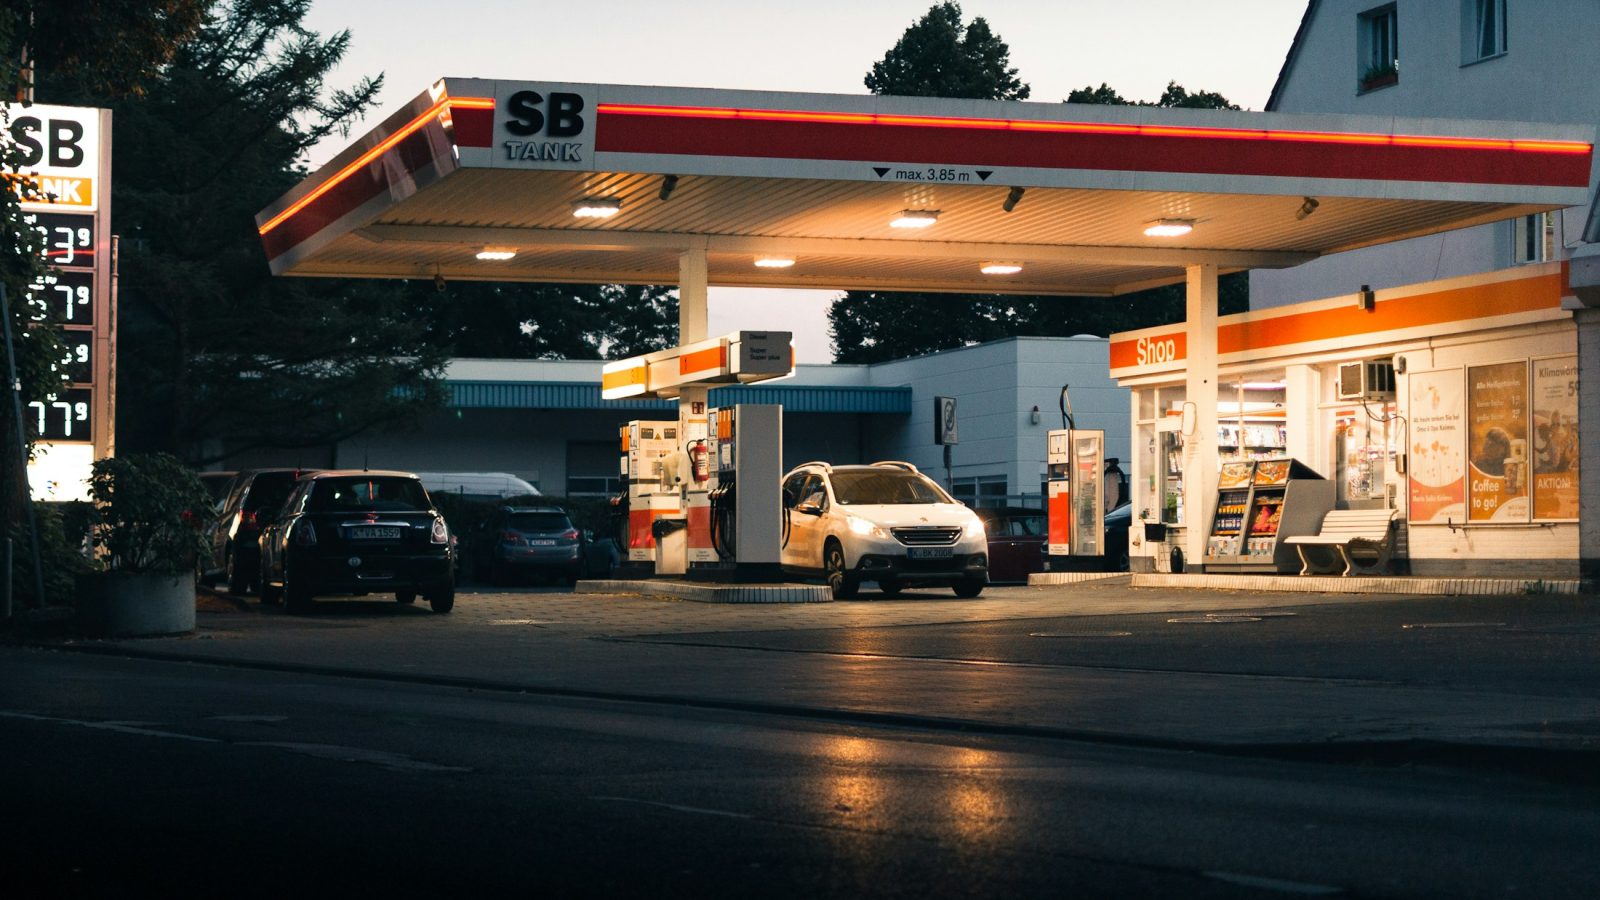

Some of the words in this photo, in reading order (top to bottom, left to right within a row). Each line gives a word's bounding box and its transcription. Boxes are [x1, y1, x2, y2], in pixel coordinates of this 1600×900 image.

[505, 90, 585, 138] SB
[9, 116, 84, 168] SB
[505, 141, 582, 162] TANK
[895, 170, 925, 181] max.
[958, 172, 970, 182] m
[1137, 338, 1176, 366] Shop
[1472, 479, 1500, 492] Coffee
[1472, 497, 1482, 508] to
[1483, 495, 1498, 511] go!
